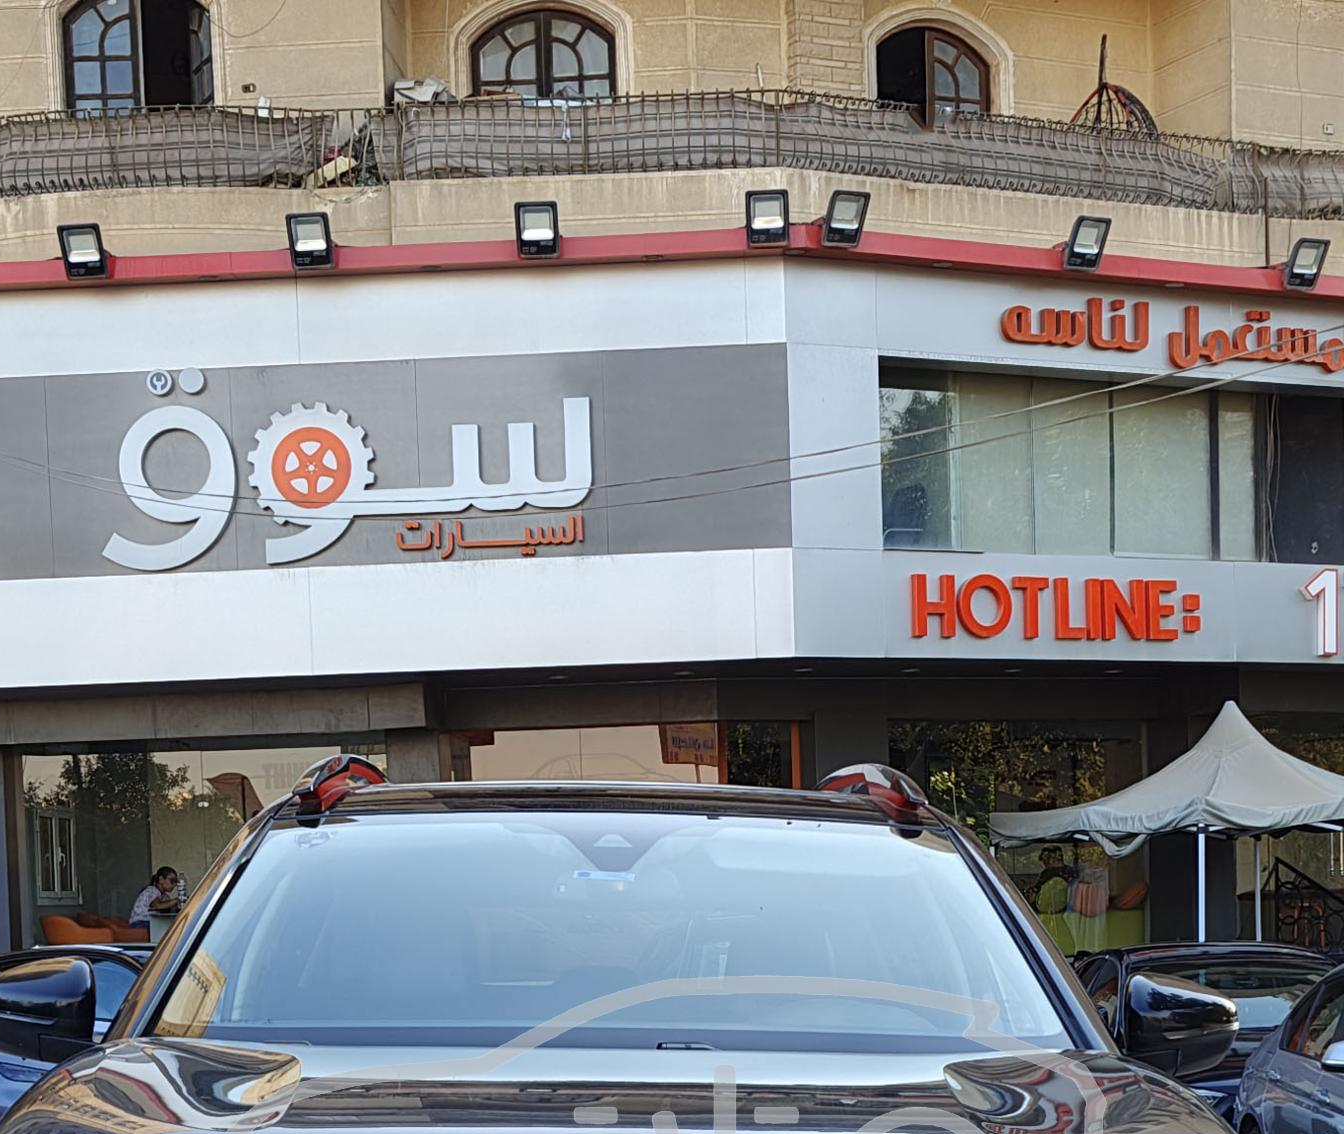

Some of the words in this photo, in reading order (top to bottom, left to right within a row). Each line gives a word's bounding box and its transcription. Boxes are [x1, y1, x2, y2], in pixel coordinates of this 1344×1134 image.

[1001, 297, 1149, 352] لناسه
[102, 367, 595, 572] سوق
[395, 515, 585, 560] السيارات
[910, 572, 1202, 643] HOTLINE:
